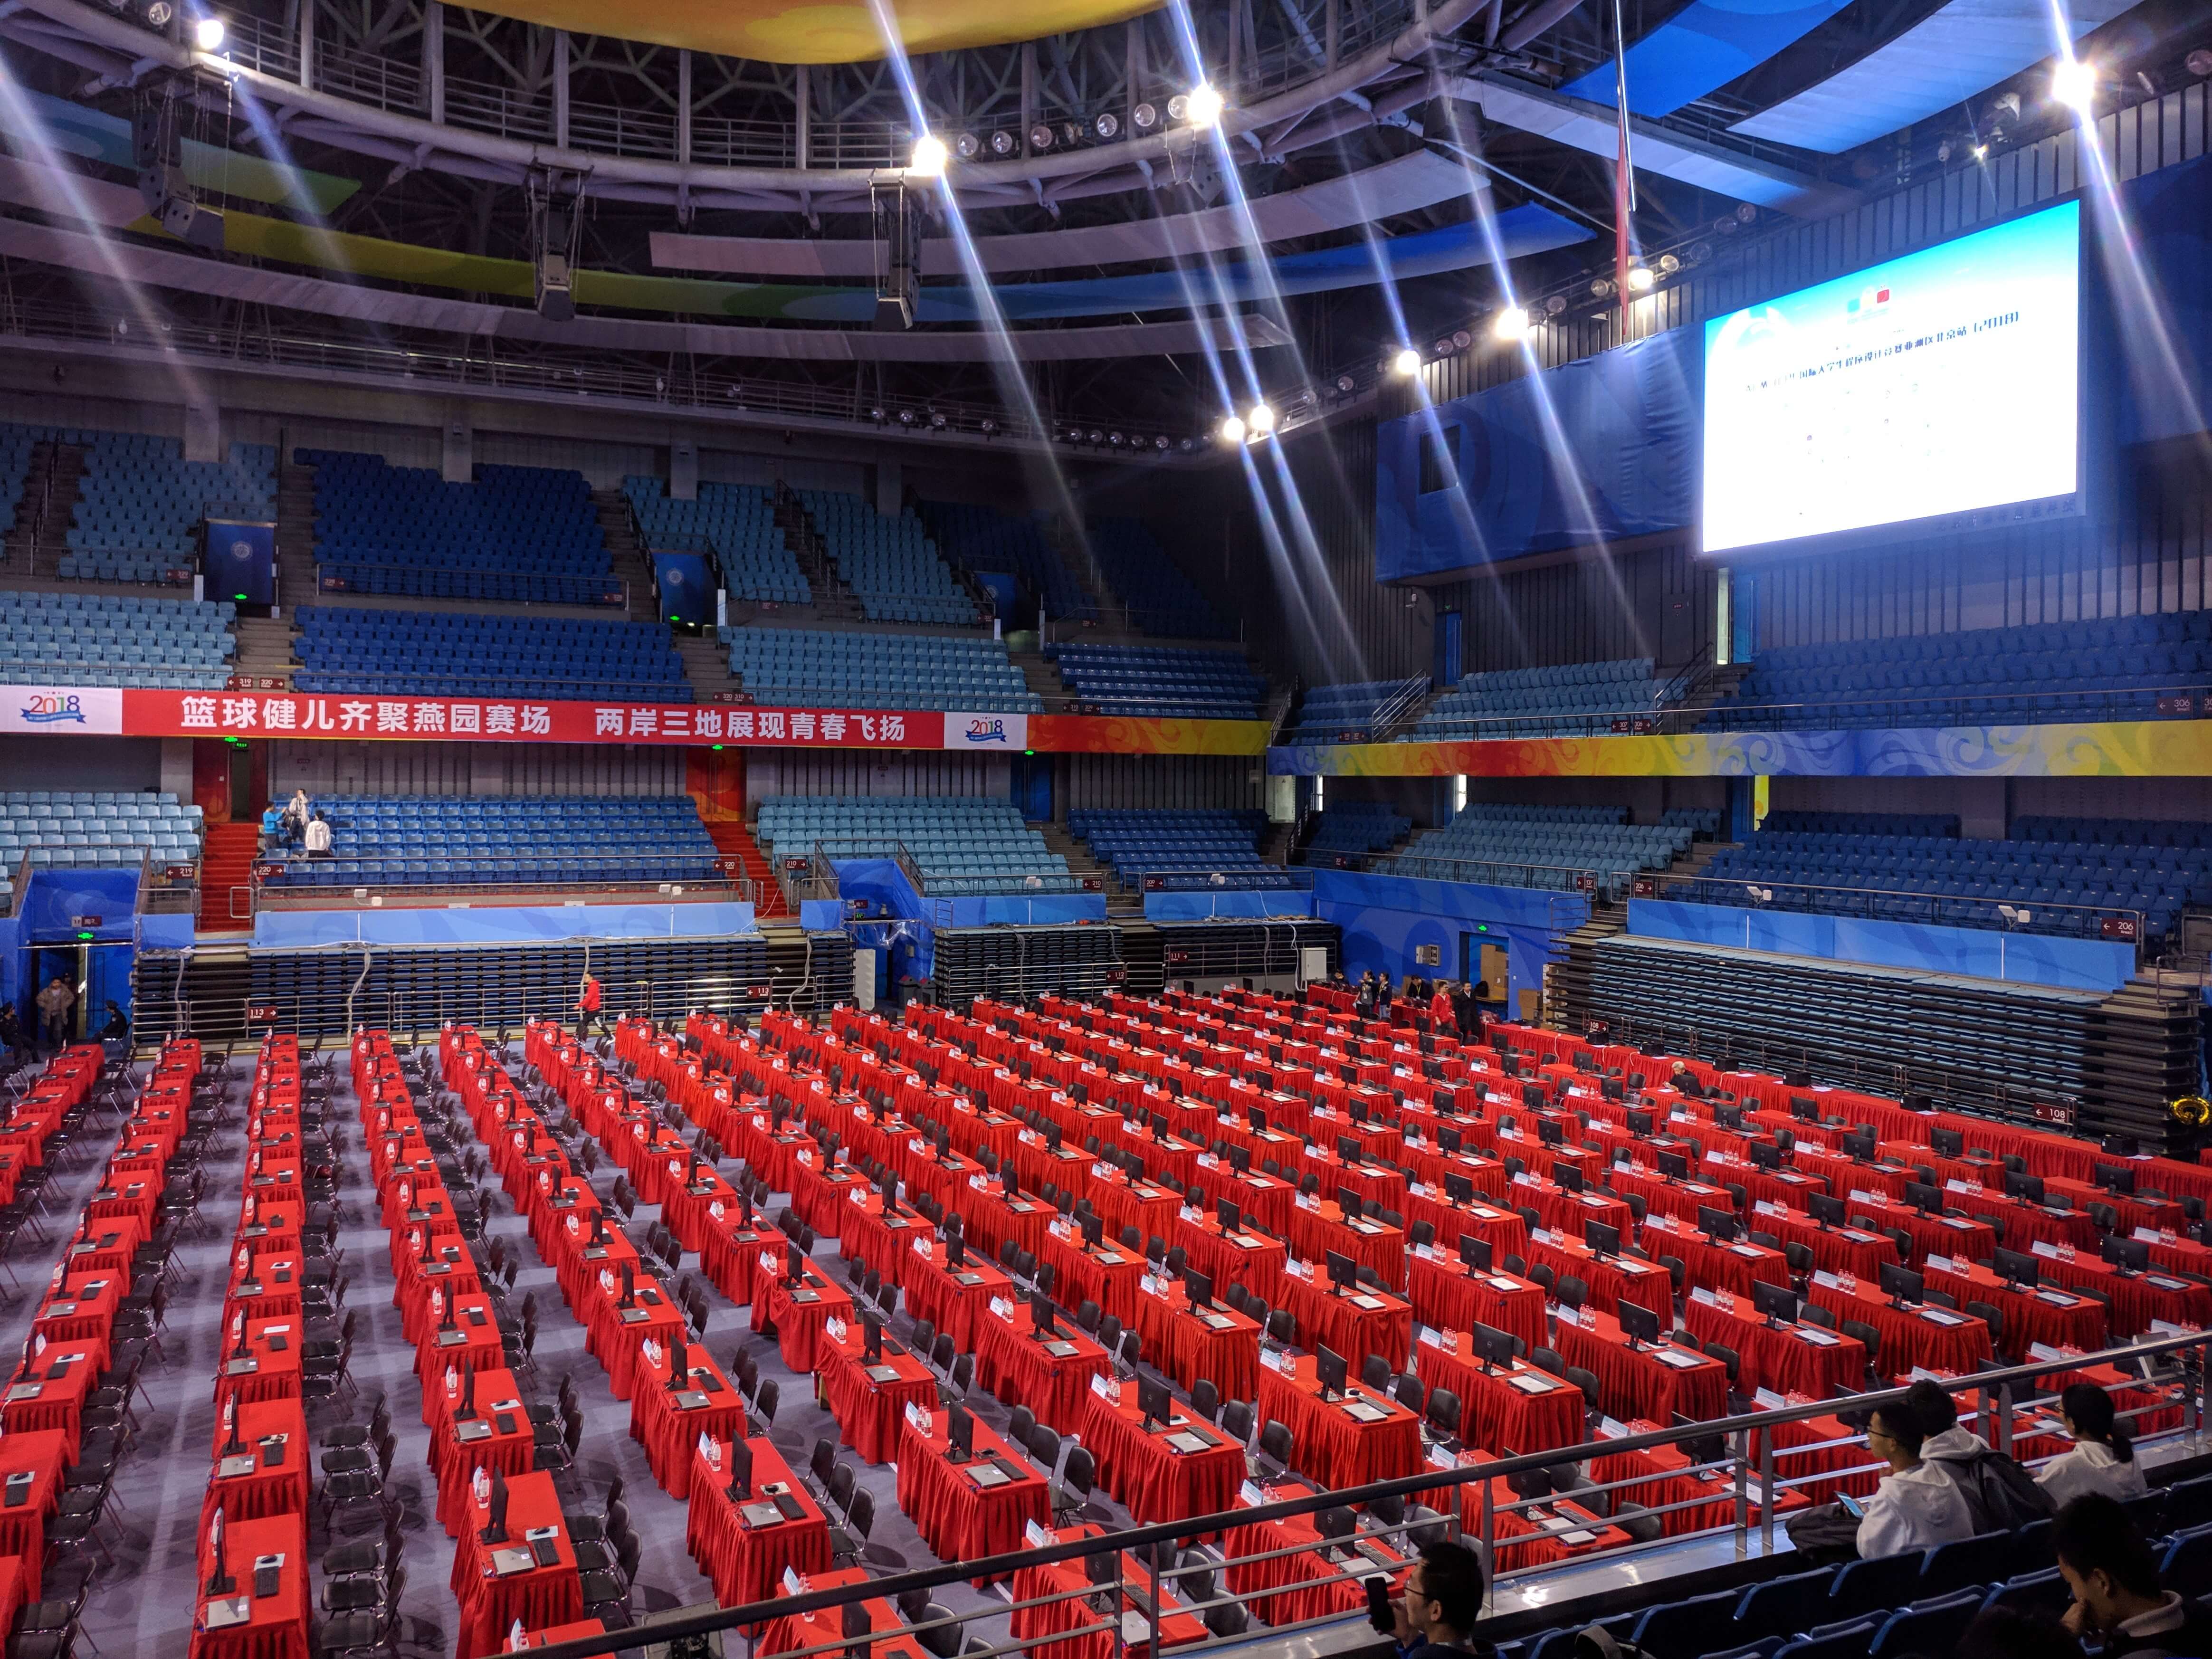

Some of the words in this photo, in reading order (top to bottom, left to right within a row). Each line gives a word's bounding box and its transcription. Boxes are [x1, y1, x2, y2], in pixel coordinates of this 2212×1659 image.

[29, 695, 80, 715] 2018
[2174, 699, 2190, 707] 306
[181, 696, 551, 735] 篮球健儿齐聚燕园赛场
[595, 707, 905, 741] 两岸三地展现青春飞扬
[971, 719, 1003, 735] 2018
[2118, 922, 2134, 930] 206
[2050, 1108, 2066, 1118] 108
